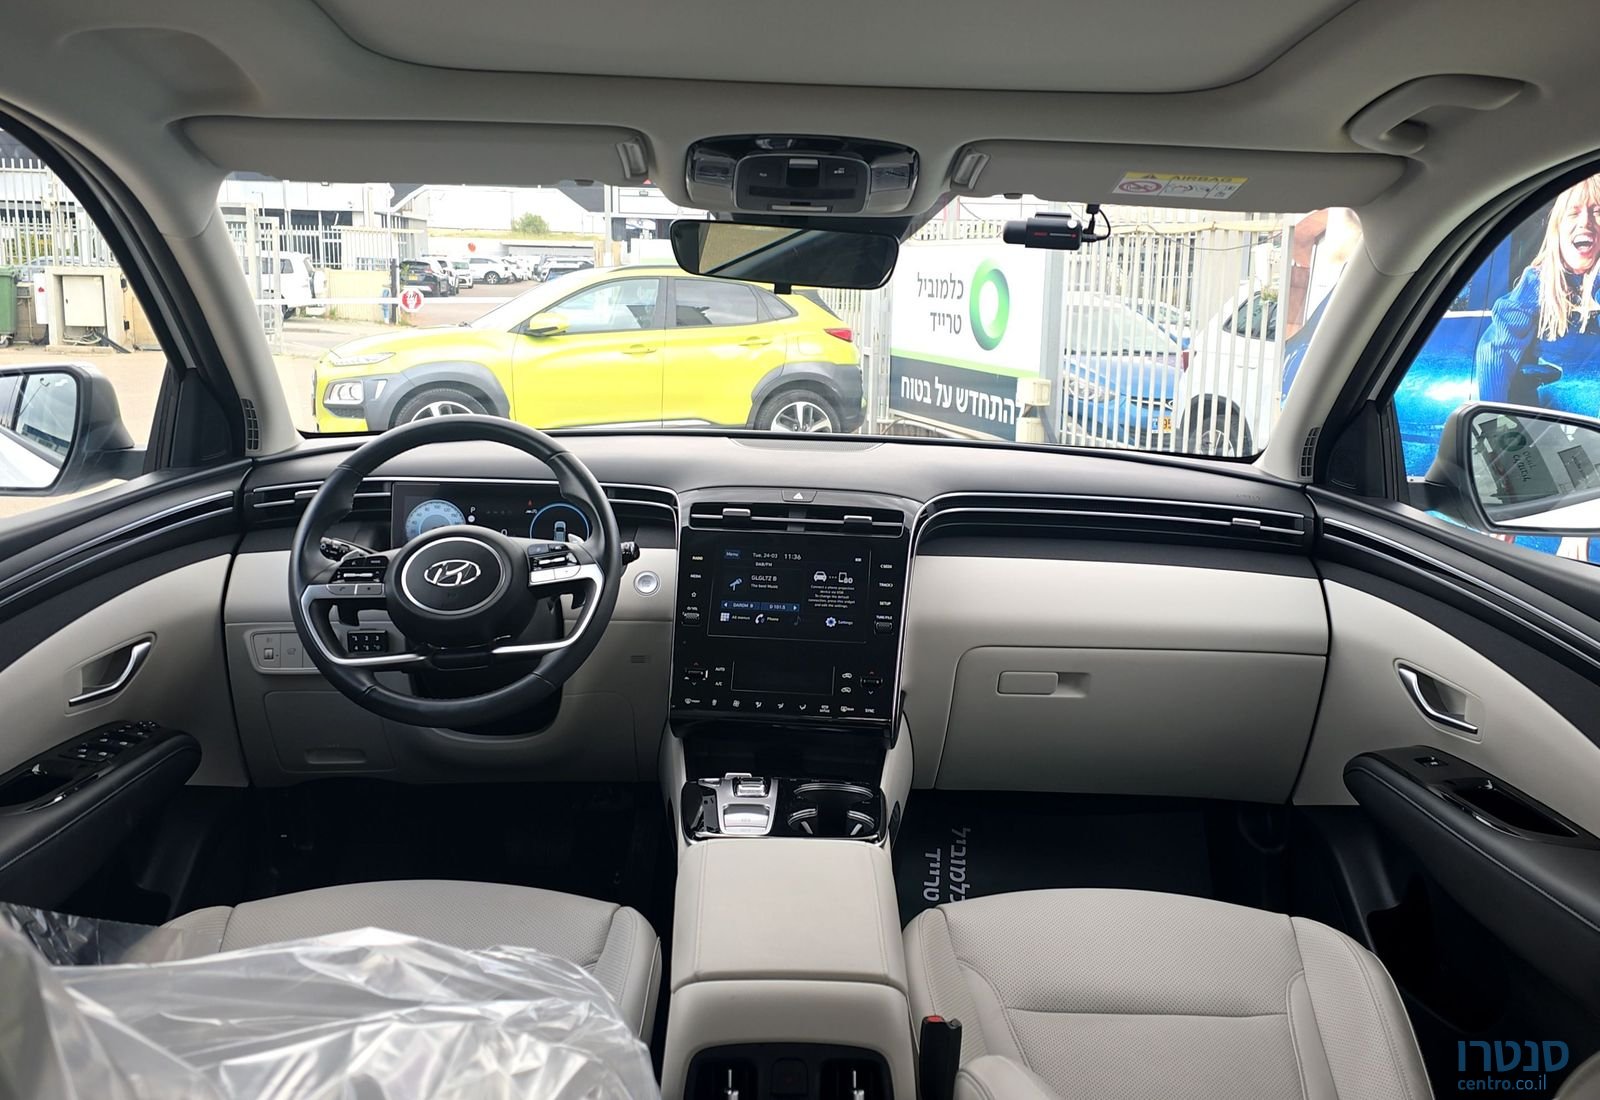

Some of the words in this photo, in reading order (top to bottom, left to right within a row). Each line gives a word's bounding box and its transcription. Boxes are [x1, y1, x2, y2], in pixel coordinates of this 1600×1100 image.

[1172, 175, 1233, 183] AIRBAG
[917, 271, 964, 300] כלמוביל
[930, 311, 962, 335] טרייד
[901, 375, 932, 405] בטוח
[934, 375, 953, 408] על
